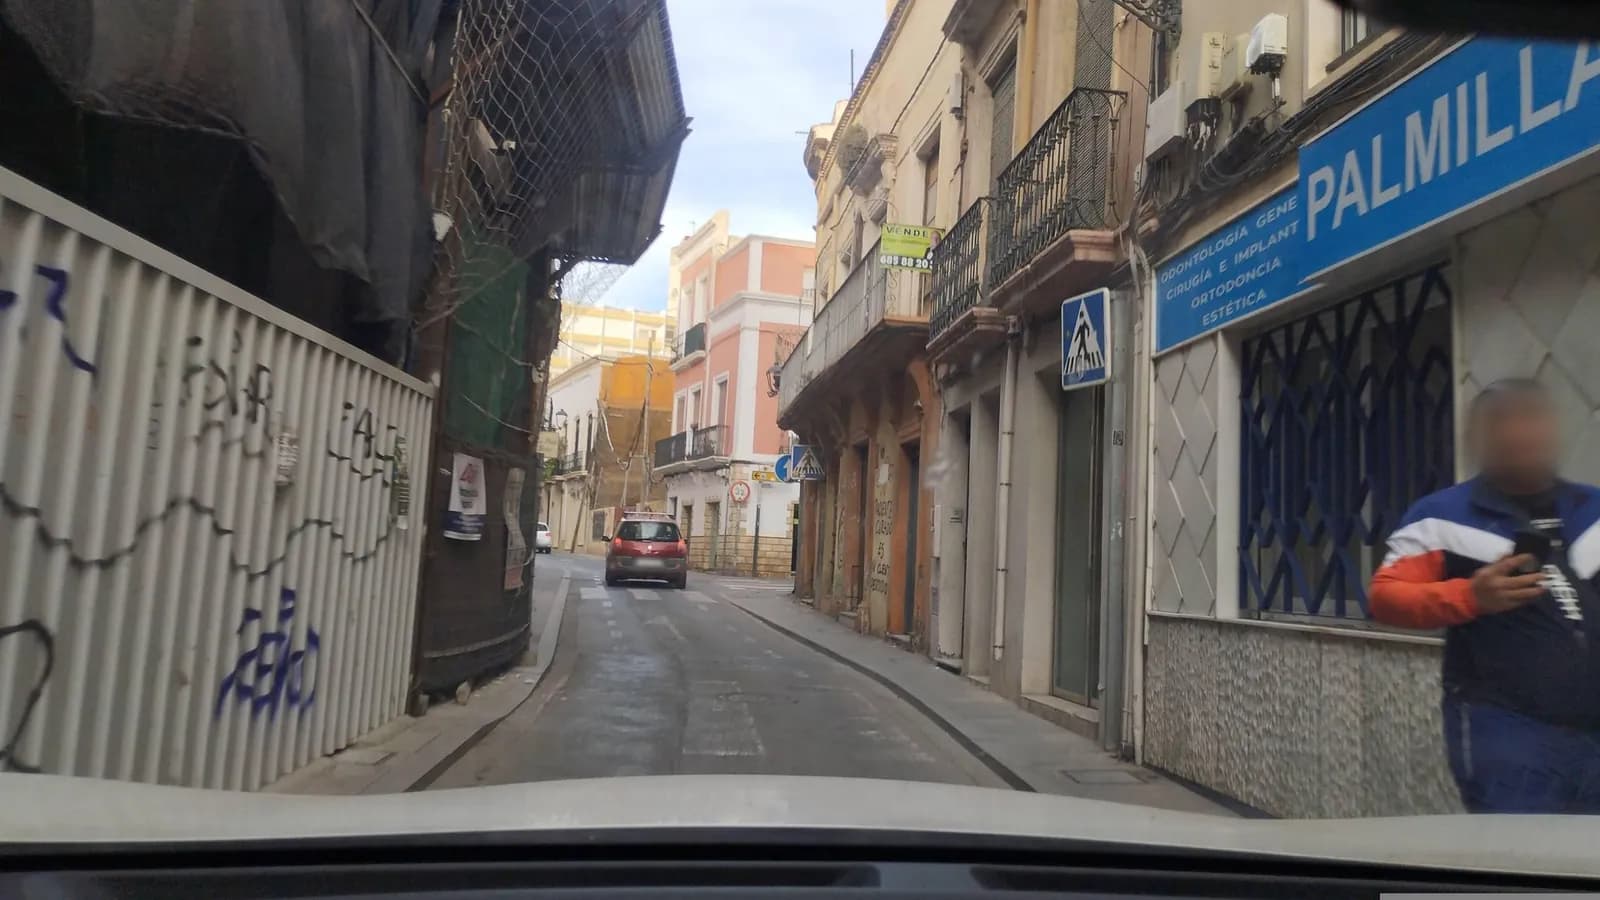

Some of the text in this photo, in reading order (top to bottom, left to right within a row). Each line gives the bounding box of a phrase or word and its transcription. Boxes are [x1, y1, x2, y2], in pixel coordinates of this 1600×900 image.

[886, 226, 929, 238] VENDE
[1160, 195, 1297, 284] ODONTOLOGÍA GENE
[1166, 220, 1299, 301] CIRUGÍA E IMPLANT
[1191, 256, 1281, 309] ORTODONCIA
[1202, 288, 1267, 326] ESTÉTICA
